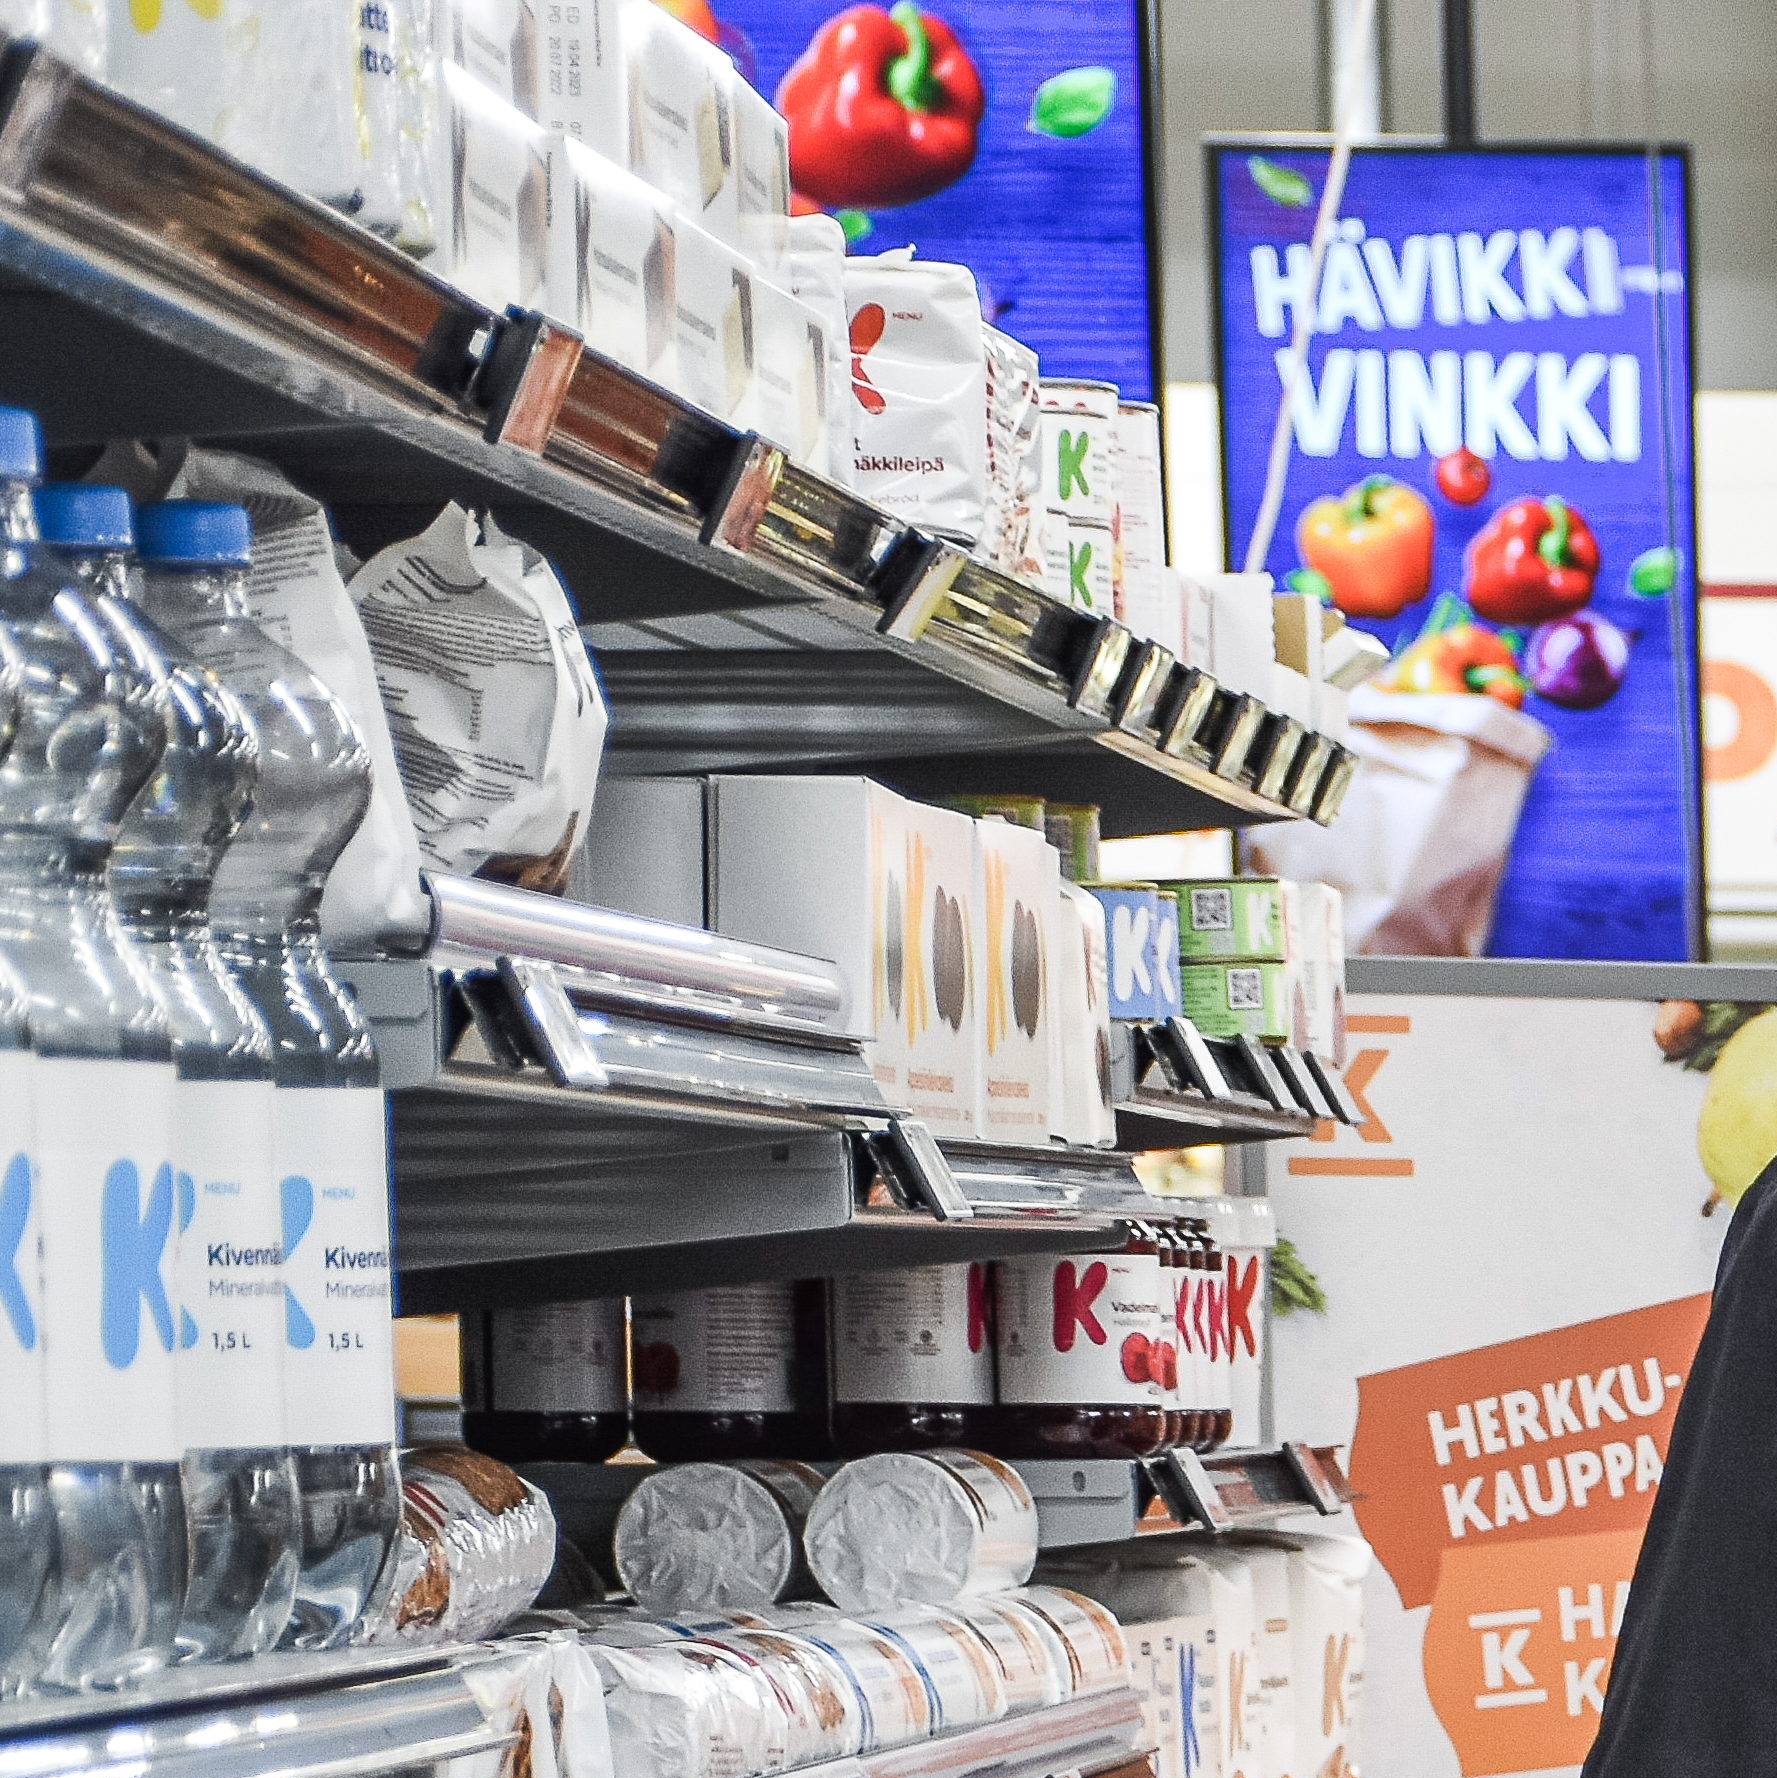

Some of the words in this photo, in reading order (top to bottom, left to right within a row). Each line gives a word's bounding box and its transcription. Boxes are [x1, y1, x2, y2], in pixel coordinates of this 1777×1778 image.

[1250, 216, 1684, 338] HÄVIKKI-
[1274, 348, 1642, 464] VINKKI
[1057, 429, 1090, 501] K
[1113, 904, 1152, 1002] K
[101, 1157, 176, 1371] K
[1053, 1260, 1109, 1354] K
[1227, 1254, 1260, 1364] K
[211, 1332, 238, 1351] 1,5
[242, 1332, 251, 1349] L
[328, 1333, 353, 1351] 1,5
[355, 1333, 364, 1349] L
[1426, 1356, 1684, 1467] HERKKU-
[1322, 1633, 1350, 1737] K
